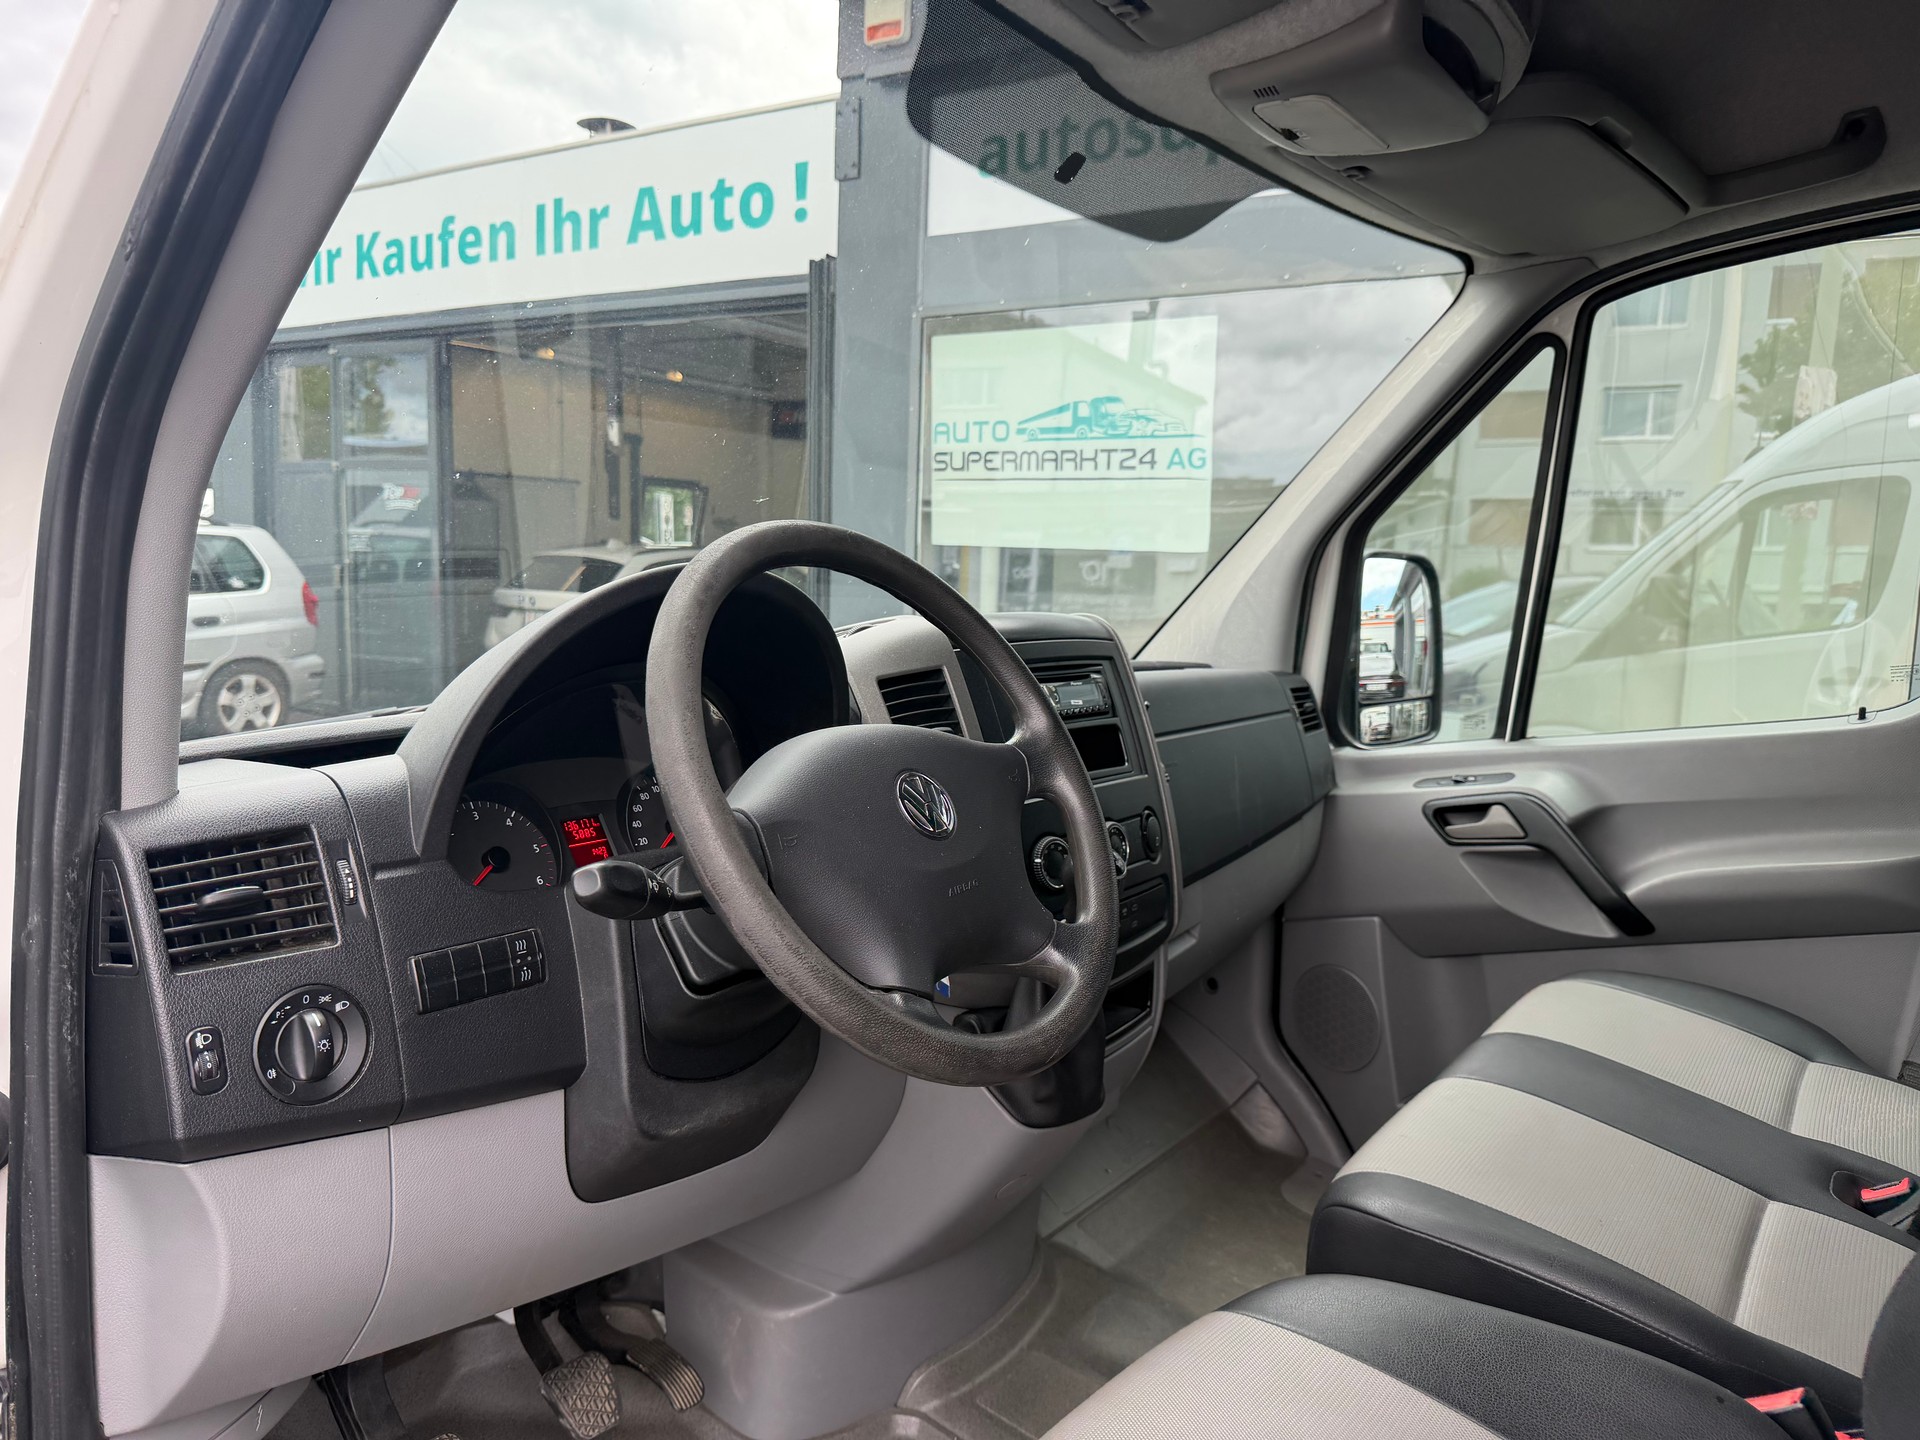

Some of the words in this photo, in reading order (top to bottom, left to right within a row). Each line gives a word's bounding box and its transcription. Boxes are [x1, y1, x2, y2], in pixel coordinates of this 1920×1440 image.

[977, 115, 1221, 177] autosu
[300, 247, 342, 288] ir
[356, 216, 516, 280] Kaufen
[536, 197, 610, 256] Ihr
[627, 178, 774, 245] Auto
[934, 420, 1010, 444] AUTO
[934, 448, 1157, 471] SUPERMARKT24
[1167, 448, 1207, 470] AG
[639, 792, 650, 800] 80
[632, 804, 643, 813] 60
[472, 811, 479, 820] 3
[506, 818, 513, 826] 4
[632, 820, 642, 828] 40
[638, 837, 648, 846] 20
[533, 844, 540, 853] 5
[536, 876, 544, 885] 6
